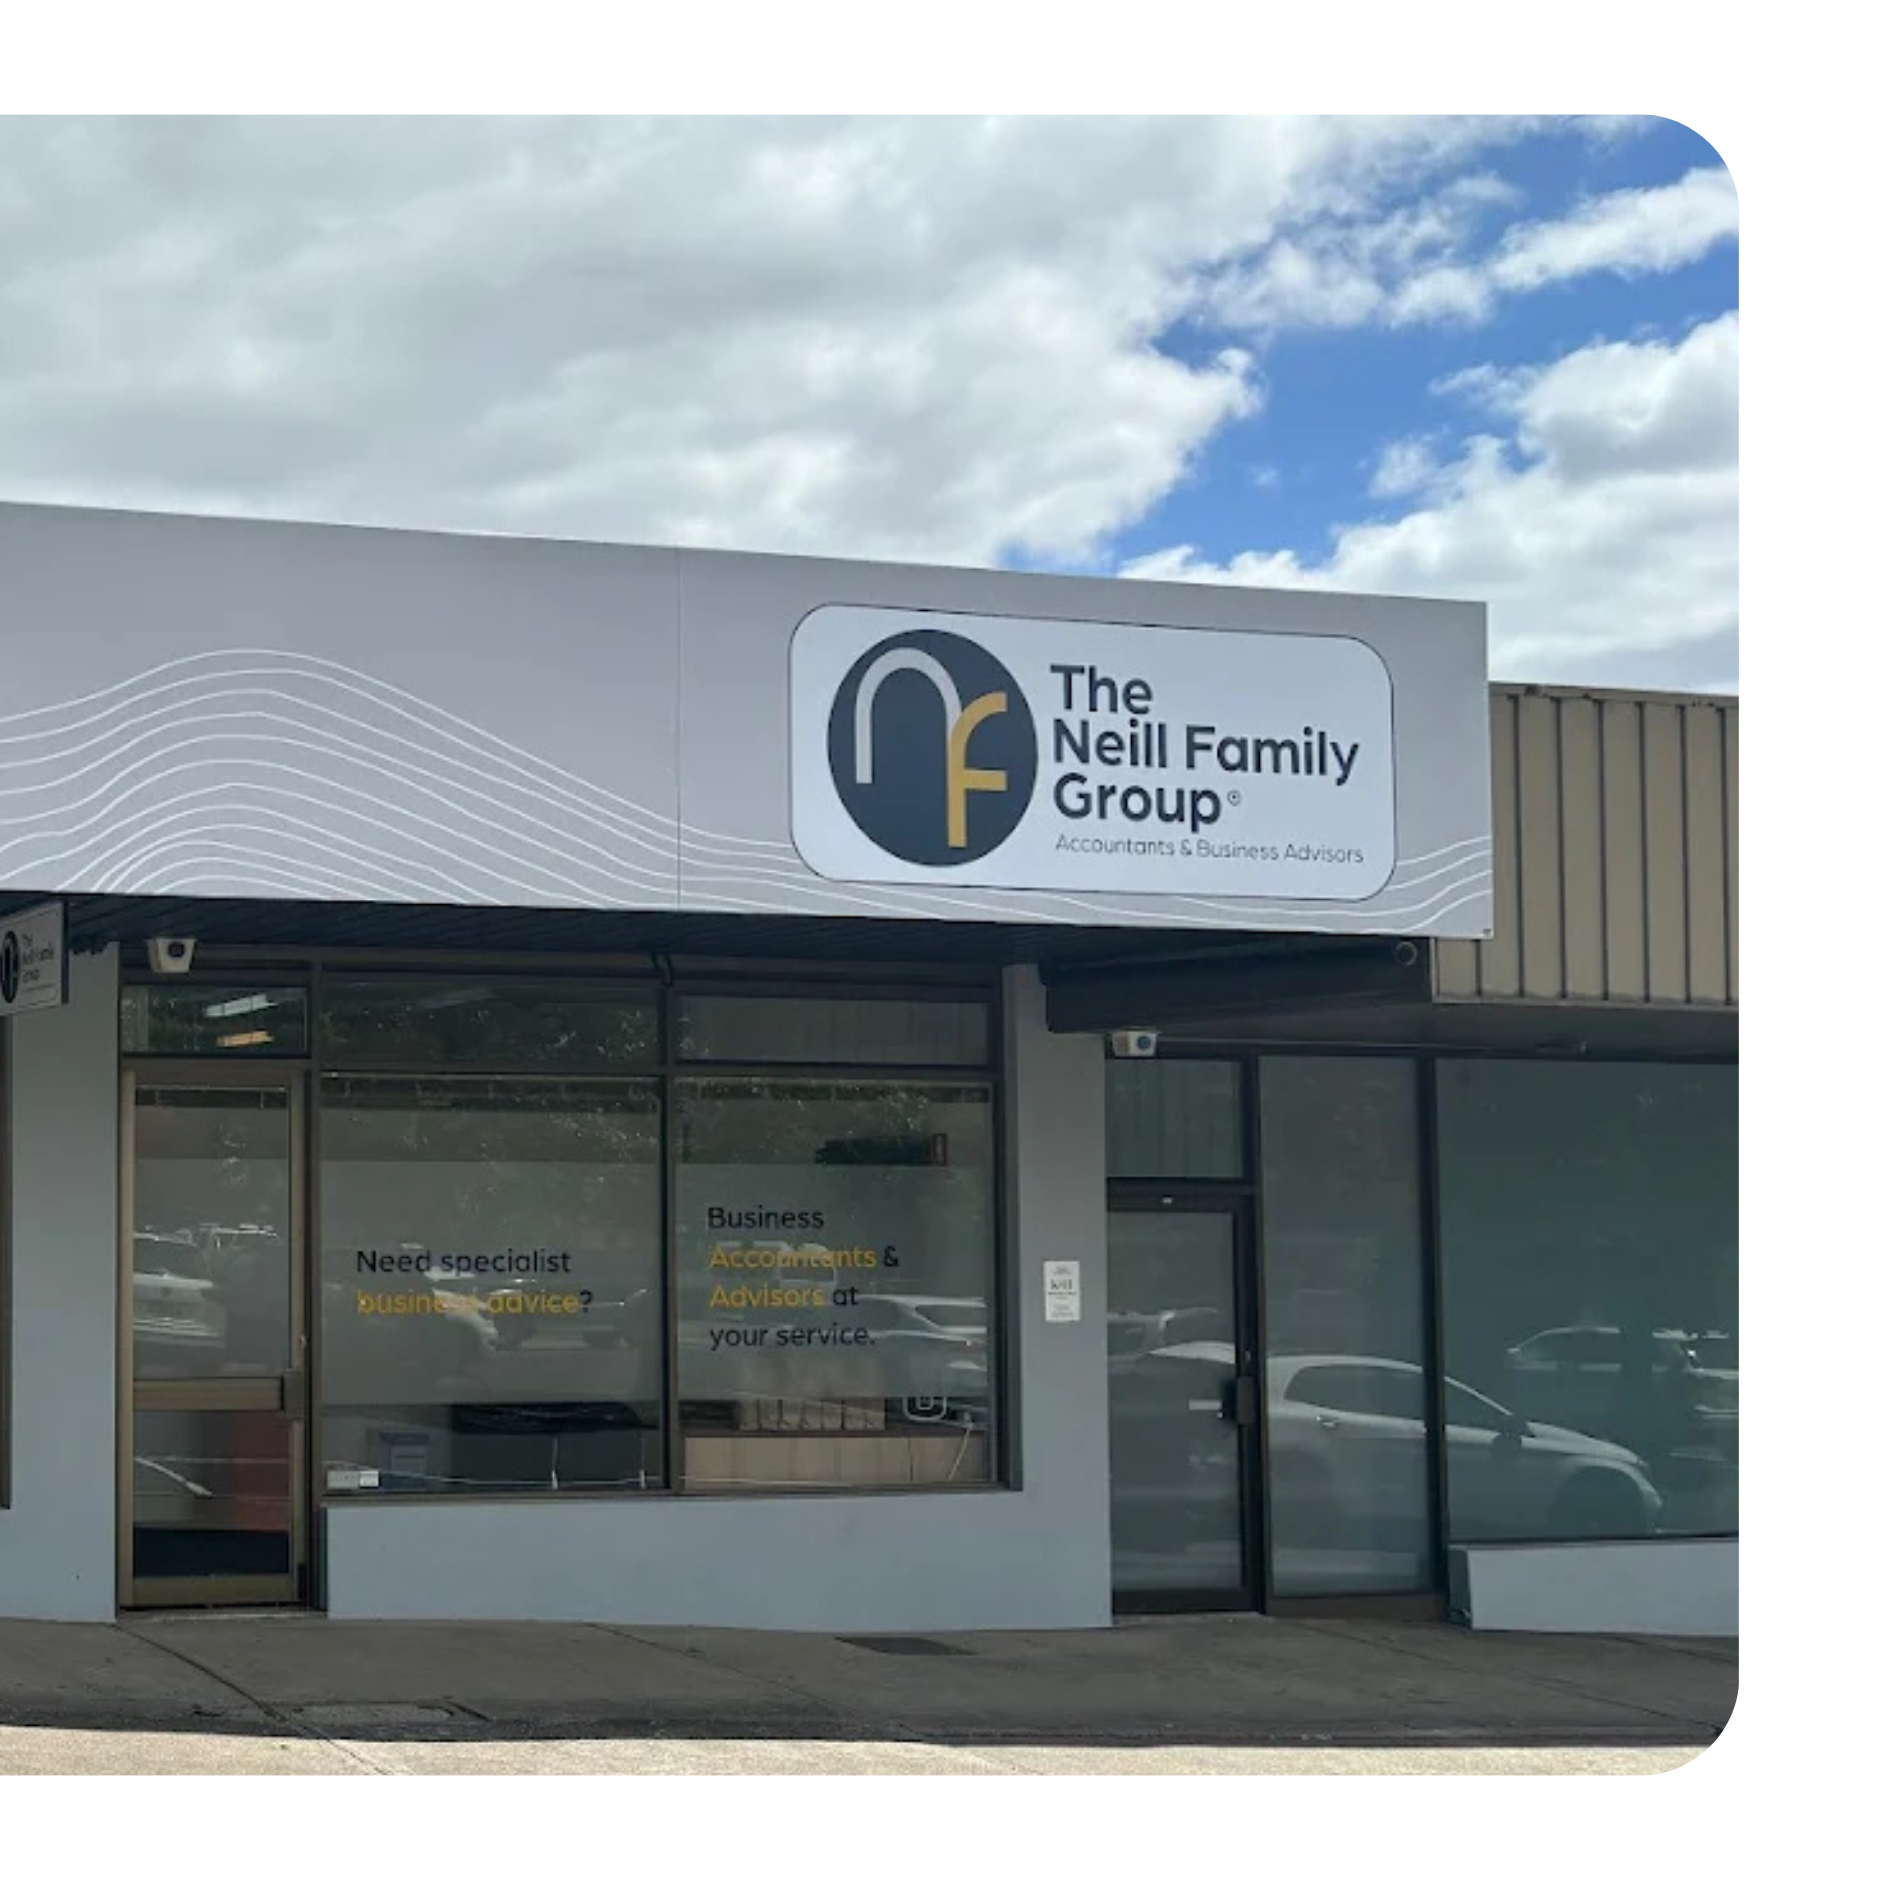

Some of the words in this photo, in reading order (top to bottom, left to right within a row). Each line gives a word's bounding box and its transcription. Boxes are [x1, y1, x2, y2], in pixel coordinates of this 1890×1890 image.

[1050, 664, 1153, 715] The
[1053, 718, 1168, 769] Neill
[1186, 726, 1359, 786] Family
[1055, 834, 1175, 857] Accountants
[1179, 839, 1193, 857] &
[1196, 839, 1280, 861] Business
[1283, 843, 1365, 864] Advisors
[708, 1205, 825, 1230] Business
[356, 1250, 432, 1273] Need
[440, 1248, 572, 1278] specialist
[709, 1245, 879, 1269] Accountants
[883, 1245, 900, 1268] &
[487, 1289, 594, 1314] advice?
[709, 1283, 828, 1309] Advisors
[833, 1286, 860, 1306] at
[709, 1327, 768, 1352] your
[776, 1322, 877, 1347] service.
